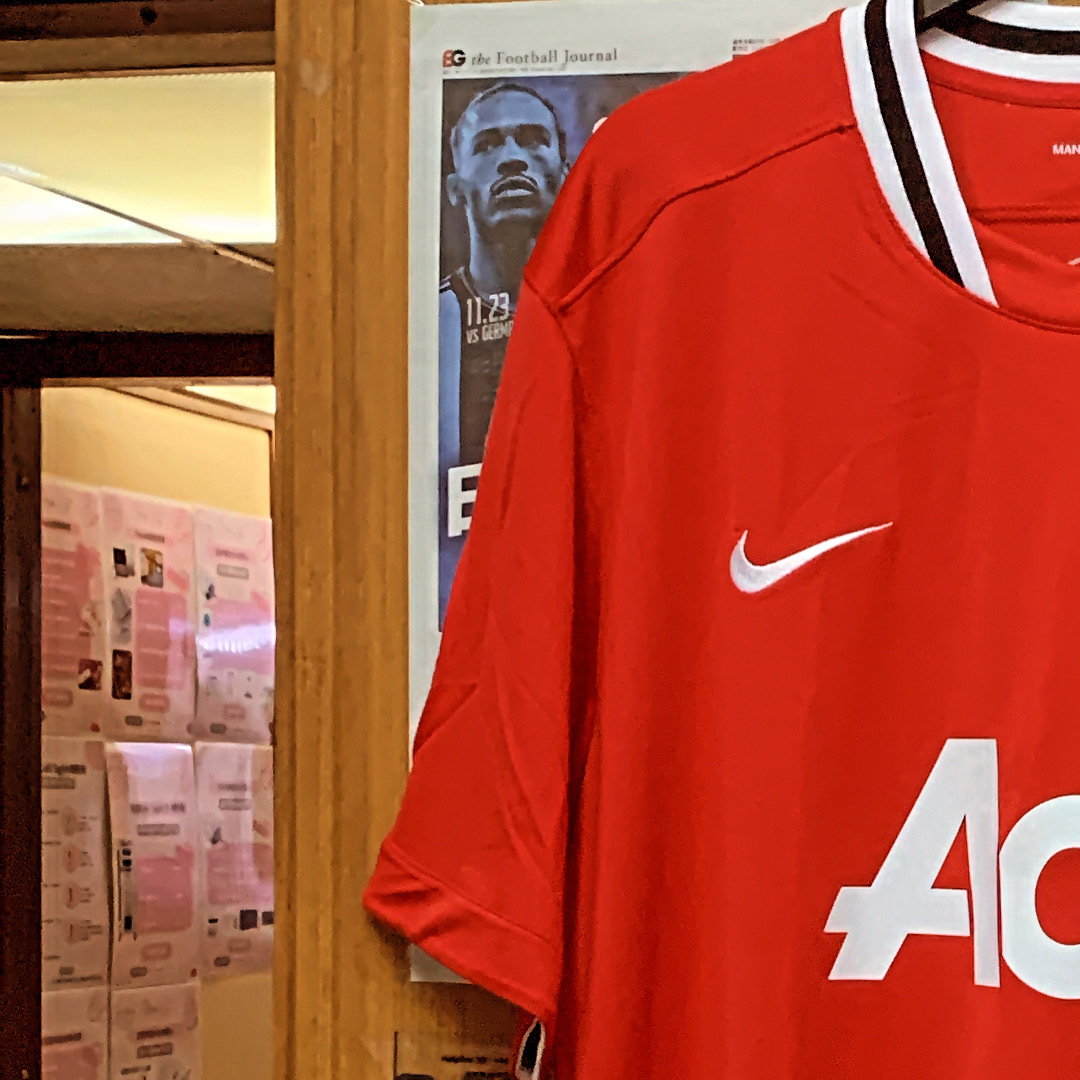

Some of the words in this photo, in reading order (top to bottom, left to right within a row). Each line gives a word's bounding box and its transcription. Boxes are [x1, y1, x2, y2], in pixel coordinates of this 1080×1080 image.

[471, 52, 491, 66] the
[496, 50, 558, 65] Football
[560, 48, 618, 69] Journal
[466, 292, 510, 327] 11.23
[466, 328, 479, 344] VS
